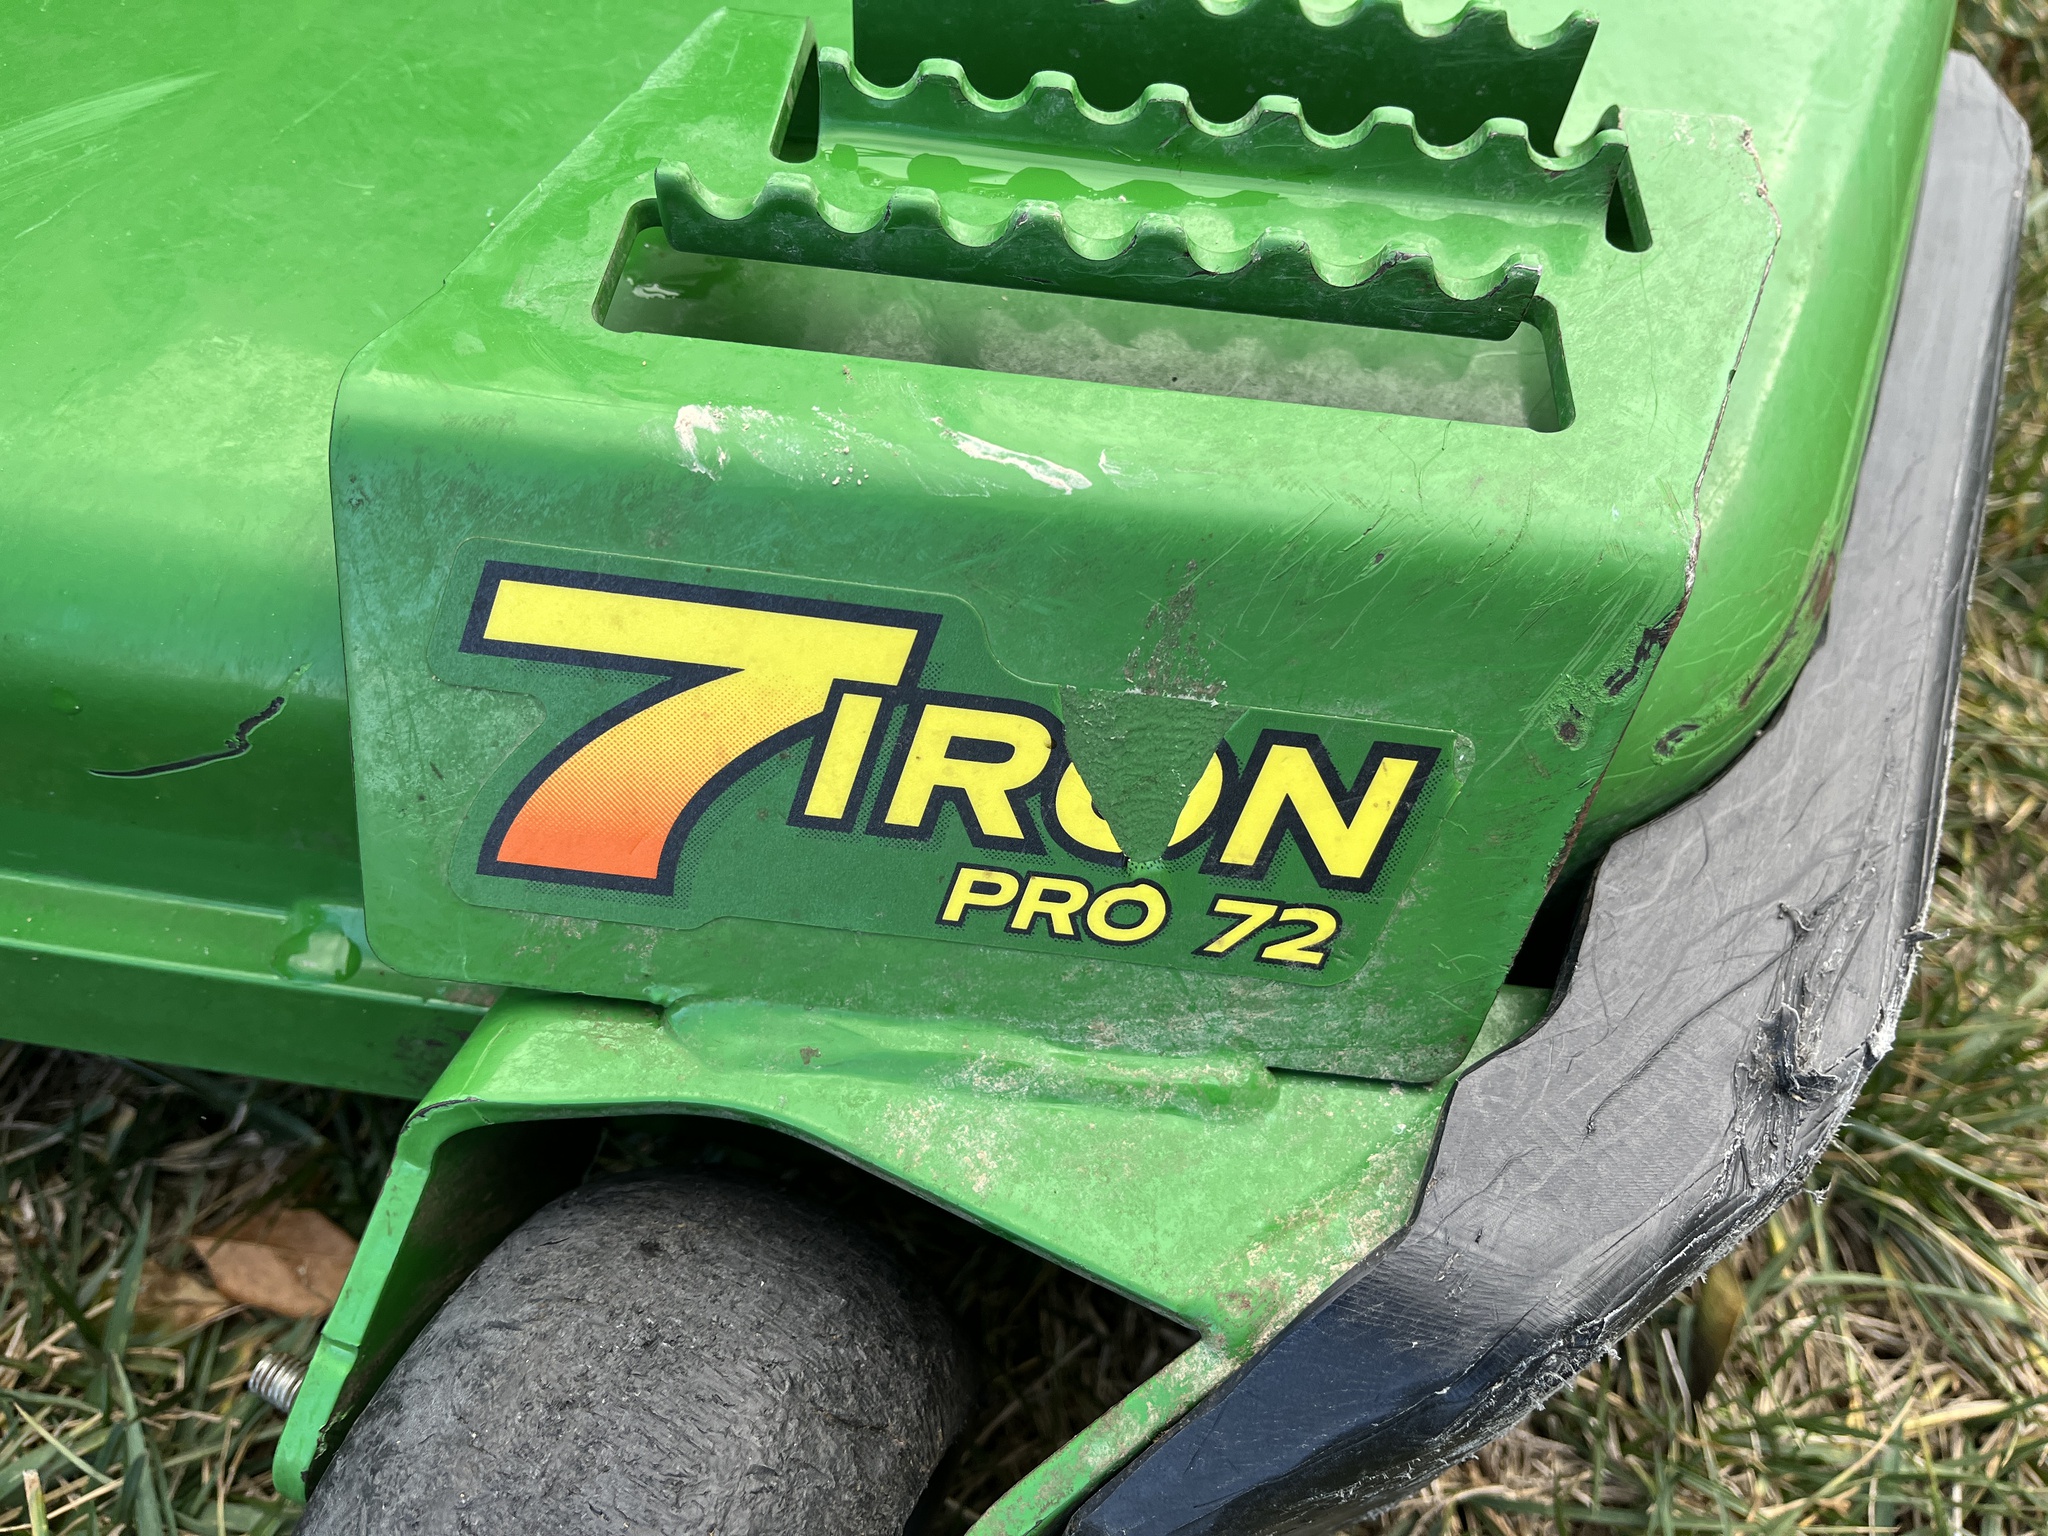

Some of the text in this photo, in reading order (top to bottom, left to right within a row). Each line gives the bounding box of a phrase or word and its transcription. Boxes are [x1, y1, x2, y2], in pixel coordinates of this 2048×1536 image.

[459, 560, 943, 896] 7
[936, 862, 1343, 970] PRO 72
